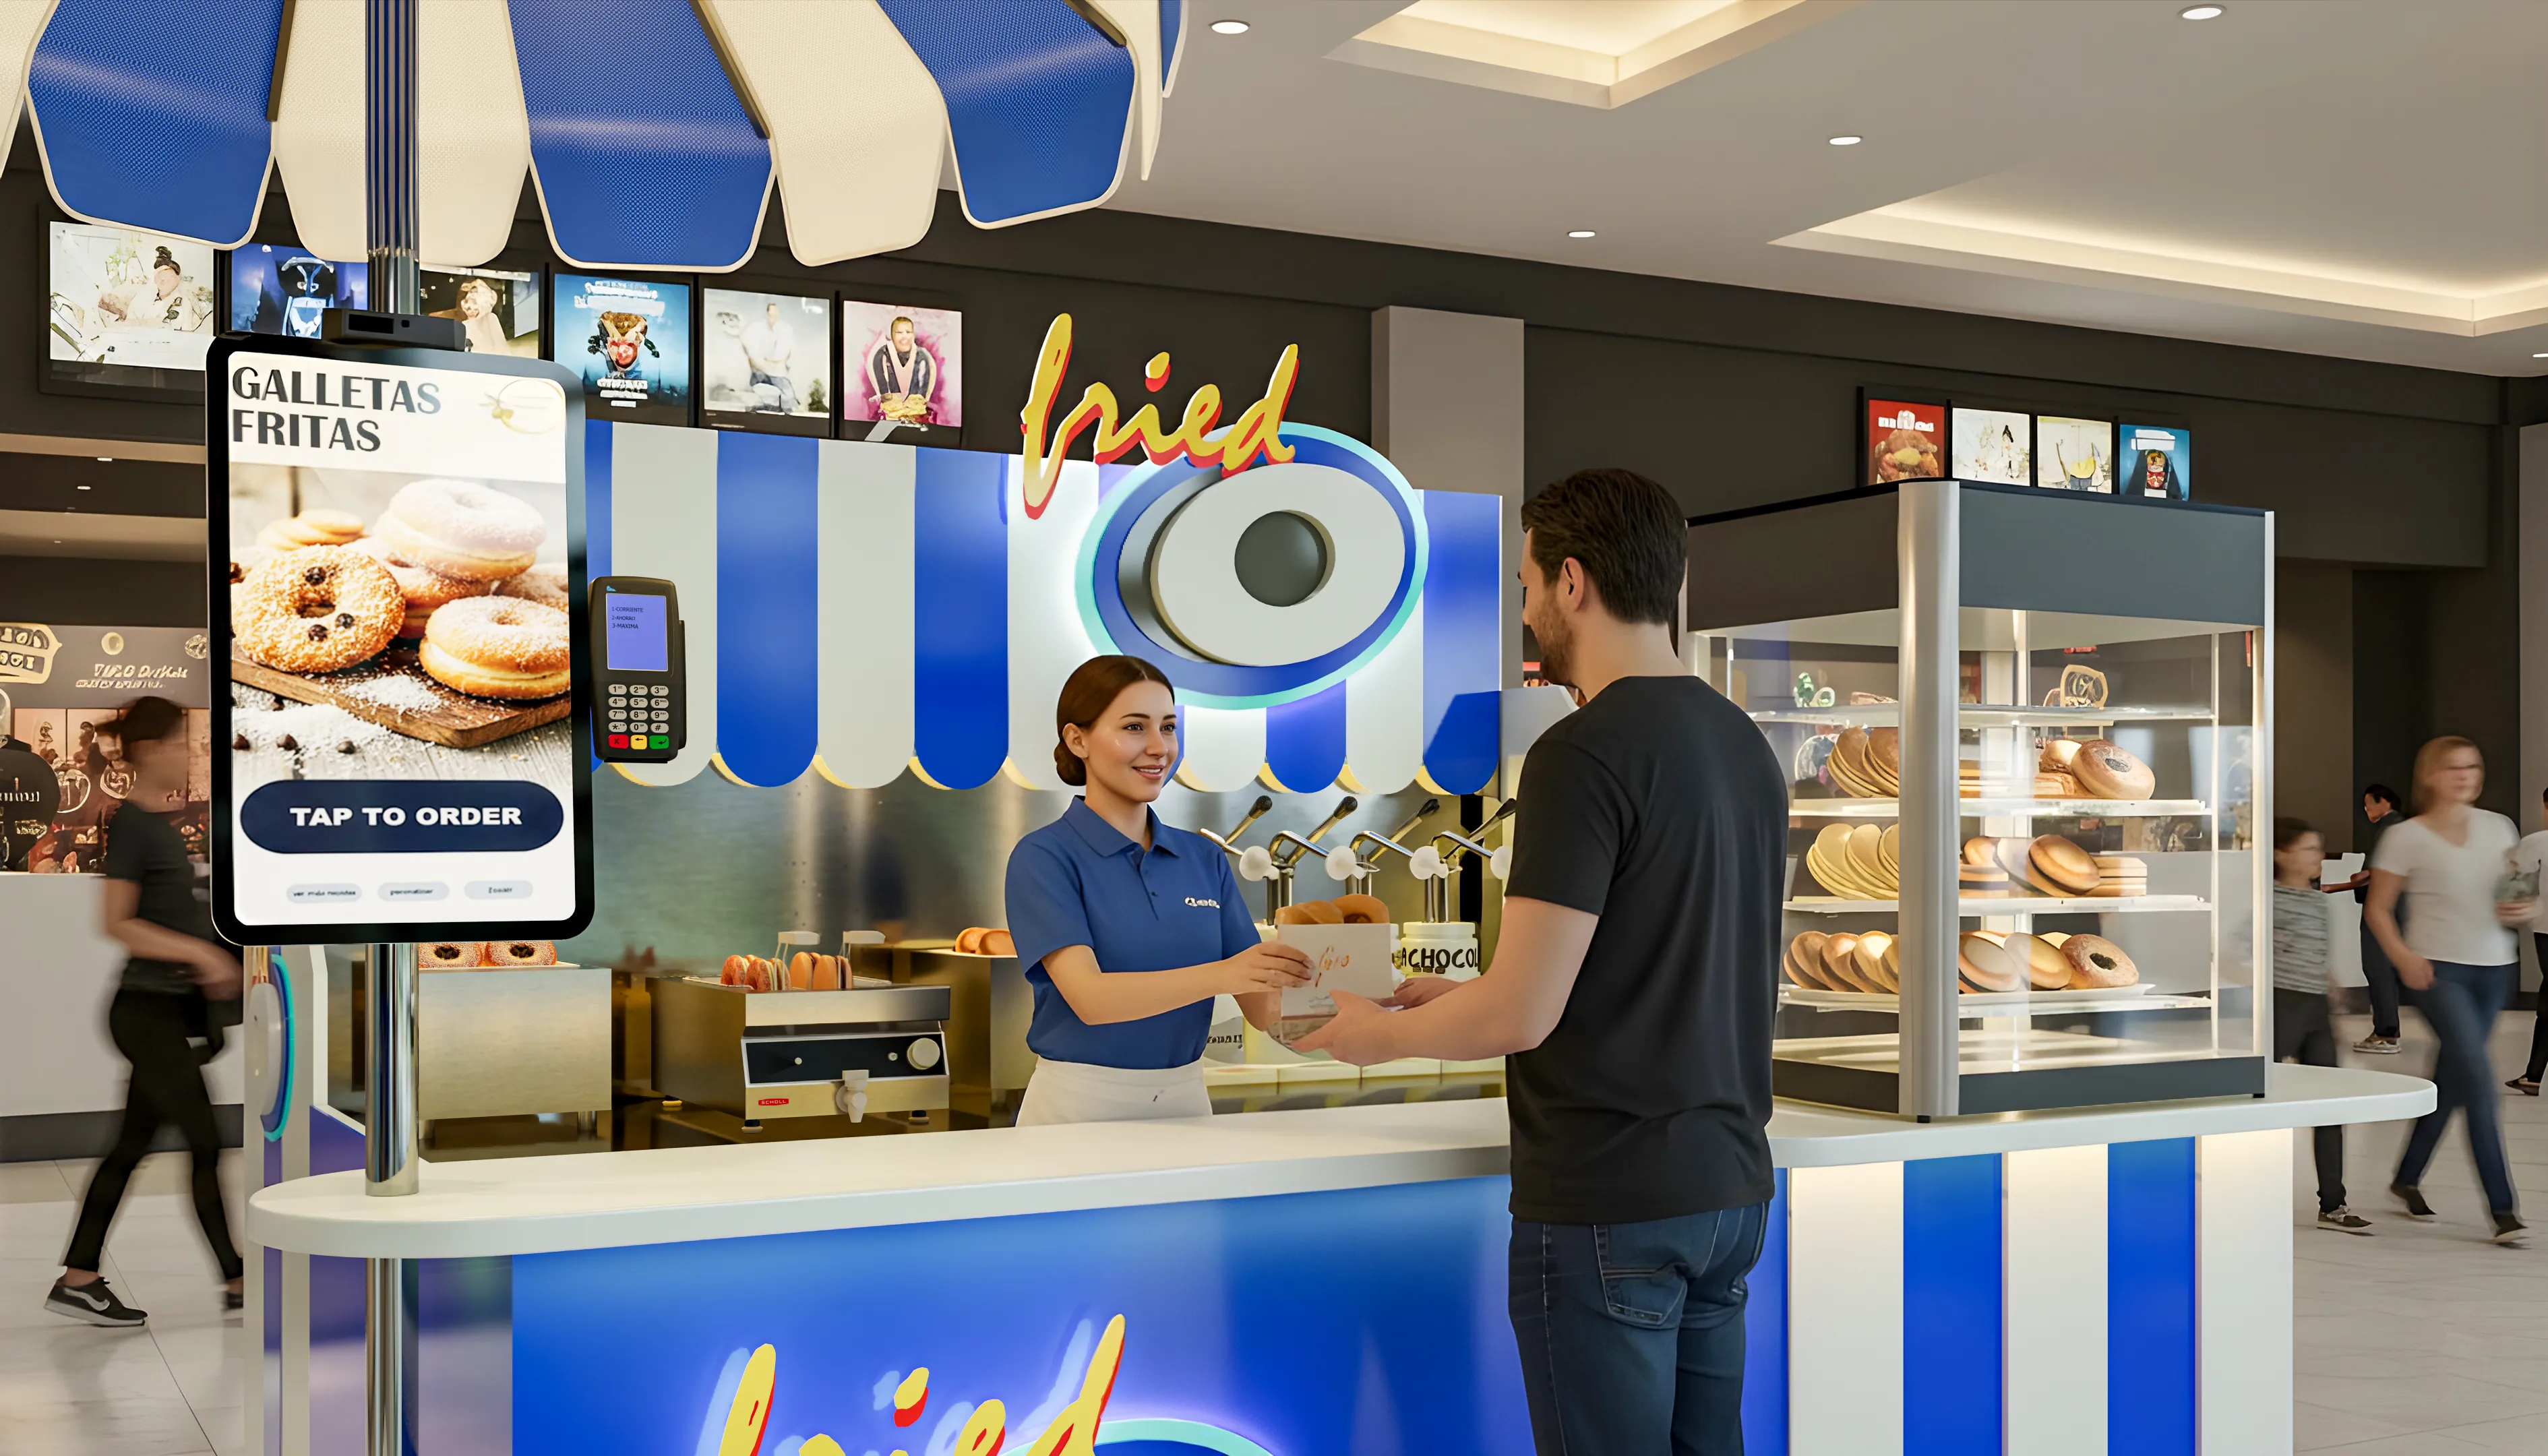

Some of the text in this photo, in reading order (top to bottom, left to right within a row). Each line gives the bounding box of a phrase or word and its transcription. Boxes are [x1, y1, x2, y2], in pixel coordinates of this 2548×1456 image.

[233, 367, 441, 414] GALLETAS
[233, 408, 381, 452] FRITAS
[1021, 313, 1299, 520] fried
[289, 807, 522, 826] TAP TO ORDER
